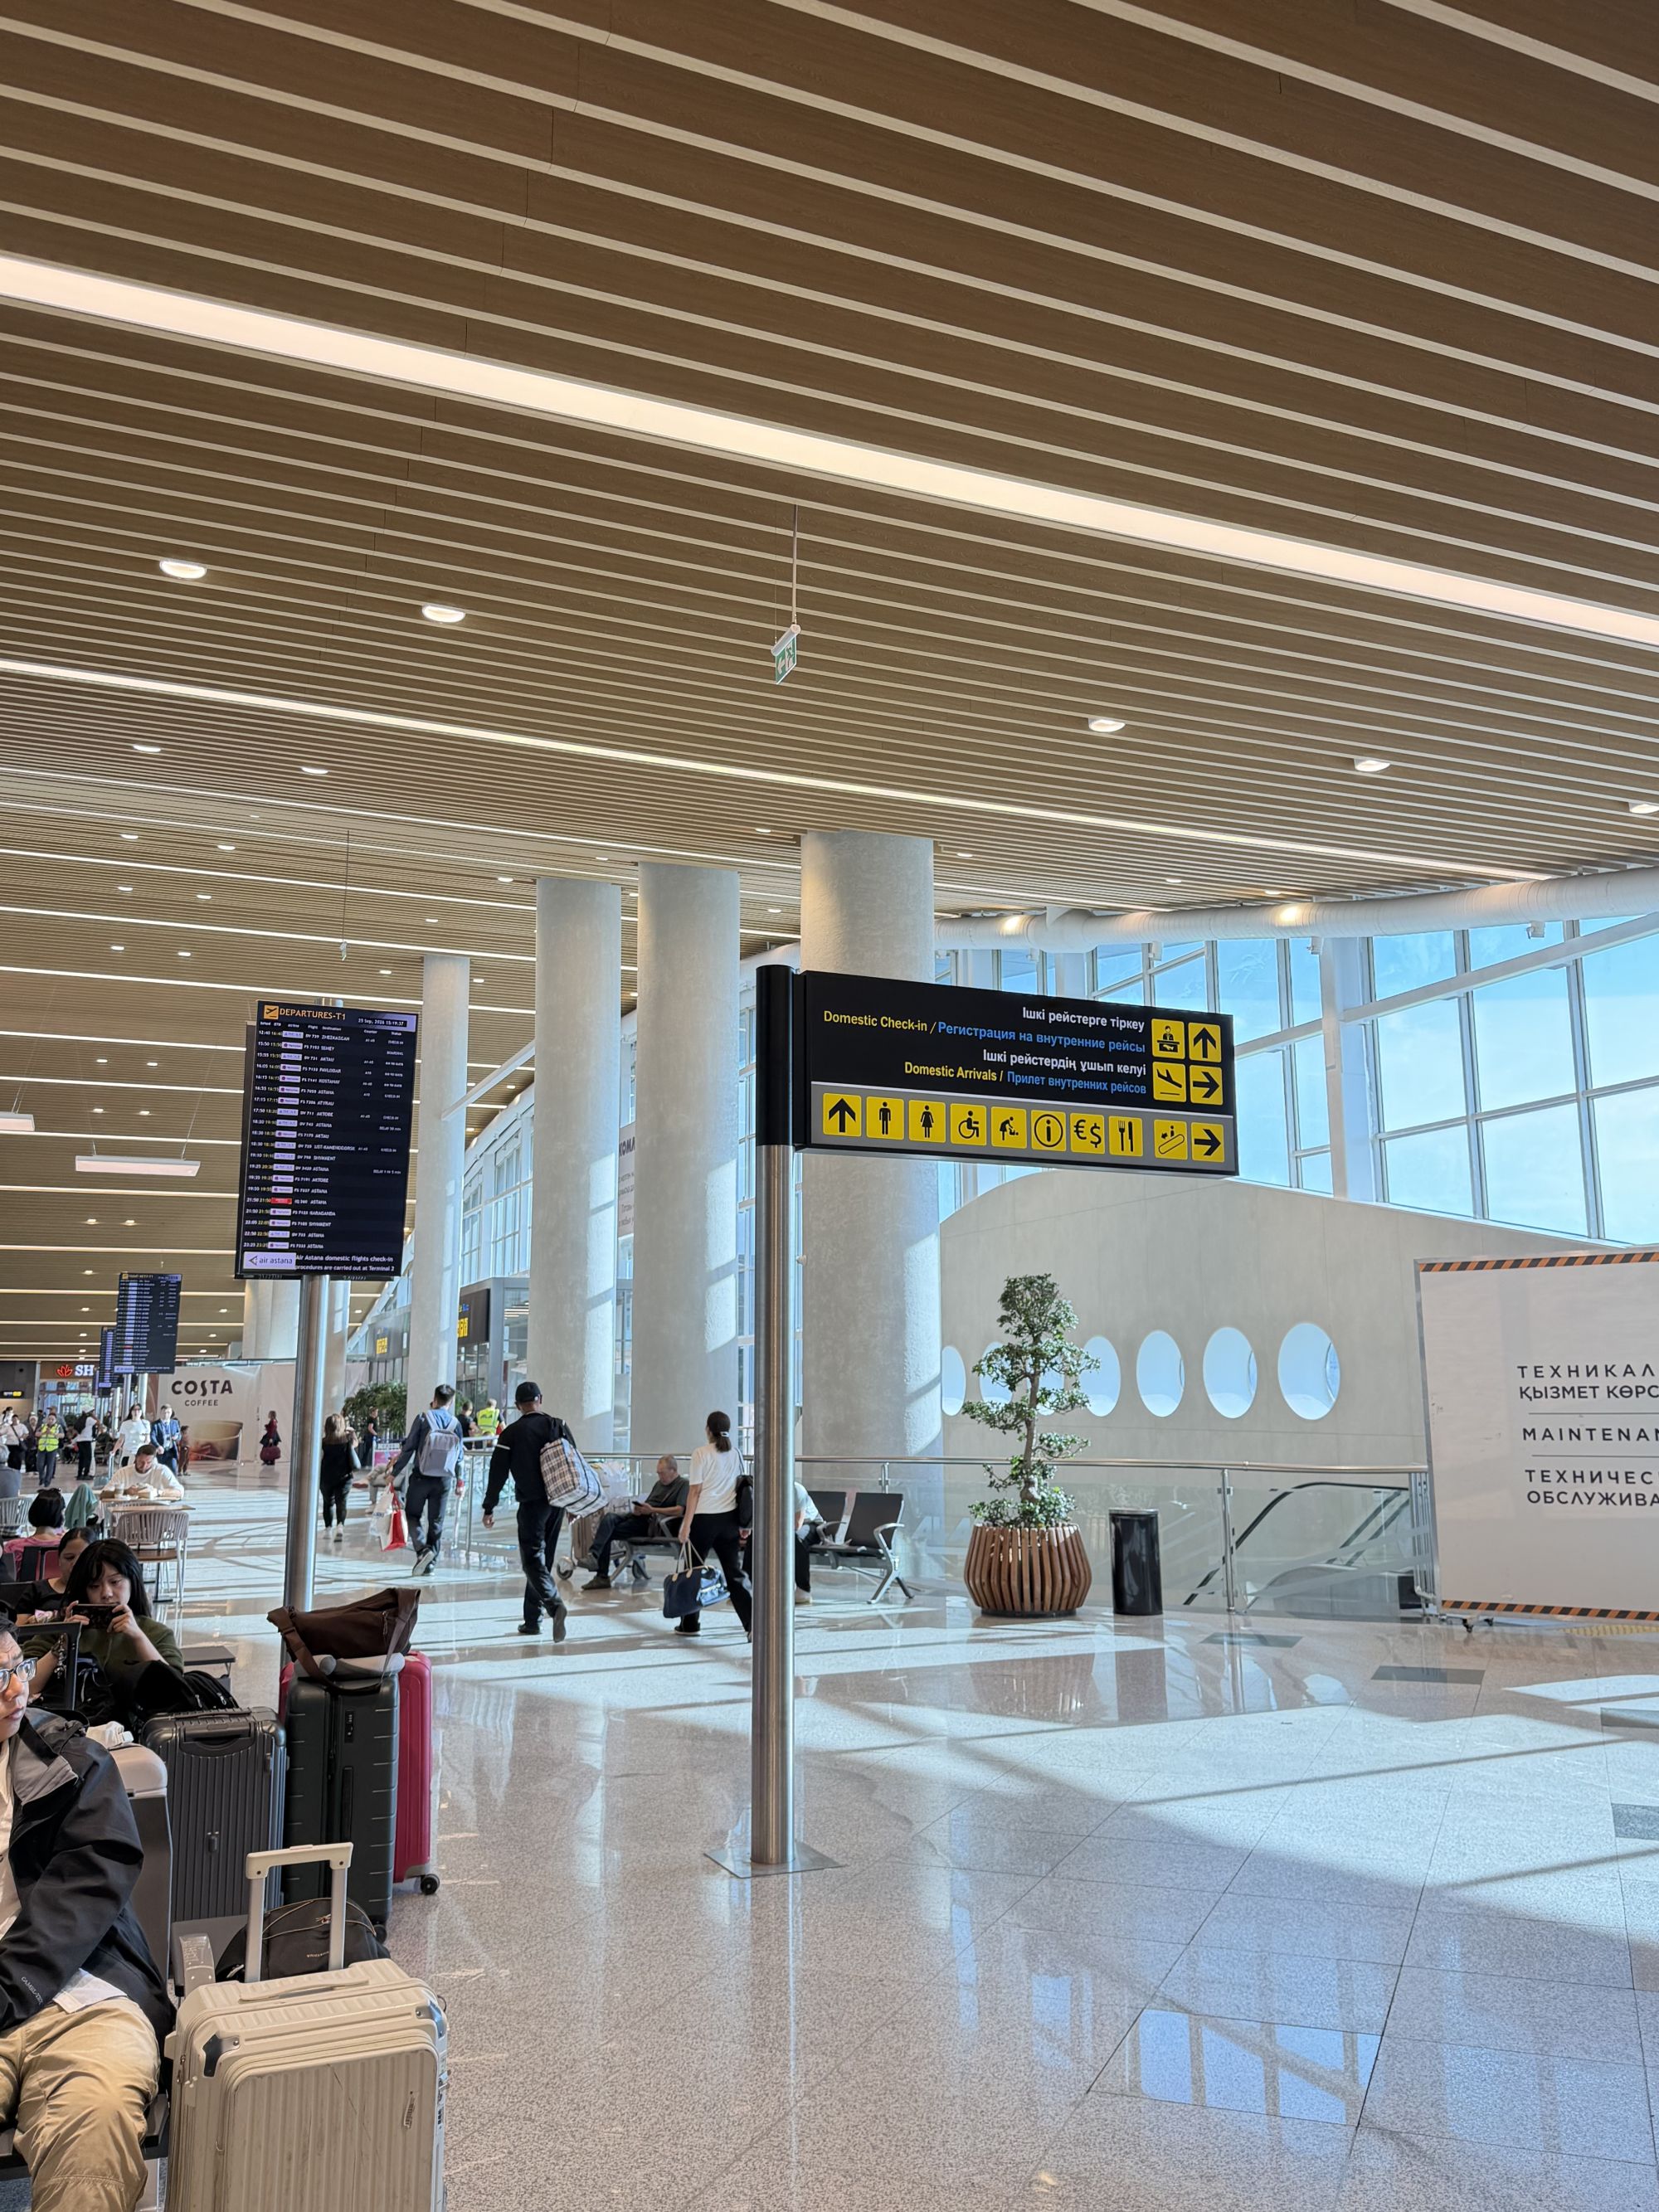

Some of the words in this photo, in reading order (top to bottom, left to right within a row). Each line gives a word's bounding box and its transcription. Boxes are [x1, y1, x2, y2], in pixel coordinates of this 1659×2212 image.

[280, 1008, 346, 1020] DEPARTURES-T1
[1023, 1007, 1045, 1020] Ішкі
[1048, 1011, 1107, 1027] рейстерге
[1110, 1017, 1145, 1033] тіркеу
[824, 1010, 878, 1026] Domestic
[880, 1016, 927, 1032] Check-in
[938, 1021, 1015, 1041] Регистрация
[1019, 1032, 1034, 1043] на
[1037, 1034, 1105, 1049] внутренние
[1108, 1040, 1146, 1053] рейсы
[983, 1049, 1007, 1062] Ішкі
[1010, 1053, 1077, 1071] рейстердің
[1080, 1060, 1114, 1073] ұшып
[1117, 1063, 1146, 1077] келуі
[904, 1062, 954, 1077] Domestic
[956, 1066, 997, 1082] Arrivals
[1007, 1072, 1045, 1086] Прилет
[1048, 1077, 1108, 1091] внутренних
[1111, 1082, 1146, 1094] рейсов
[1517, 1364, 1655, 1378] ТЕХНИКАЛ
[171, 1380, 233, 1397] COSTA
[1520, 1386, 1599, 1402] ҚЫЗМЕТ
[1607, 1385, 1659, 1398] КӨРС
[1525, 1469, 1659, 1485] ТЕХНИЧЕС
[1527, 1490, 1659, 1506] ОБСЛУЖИВА
